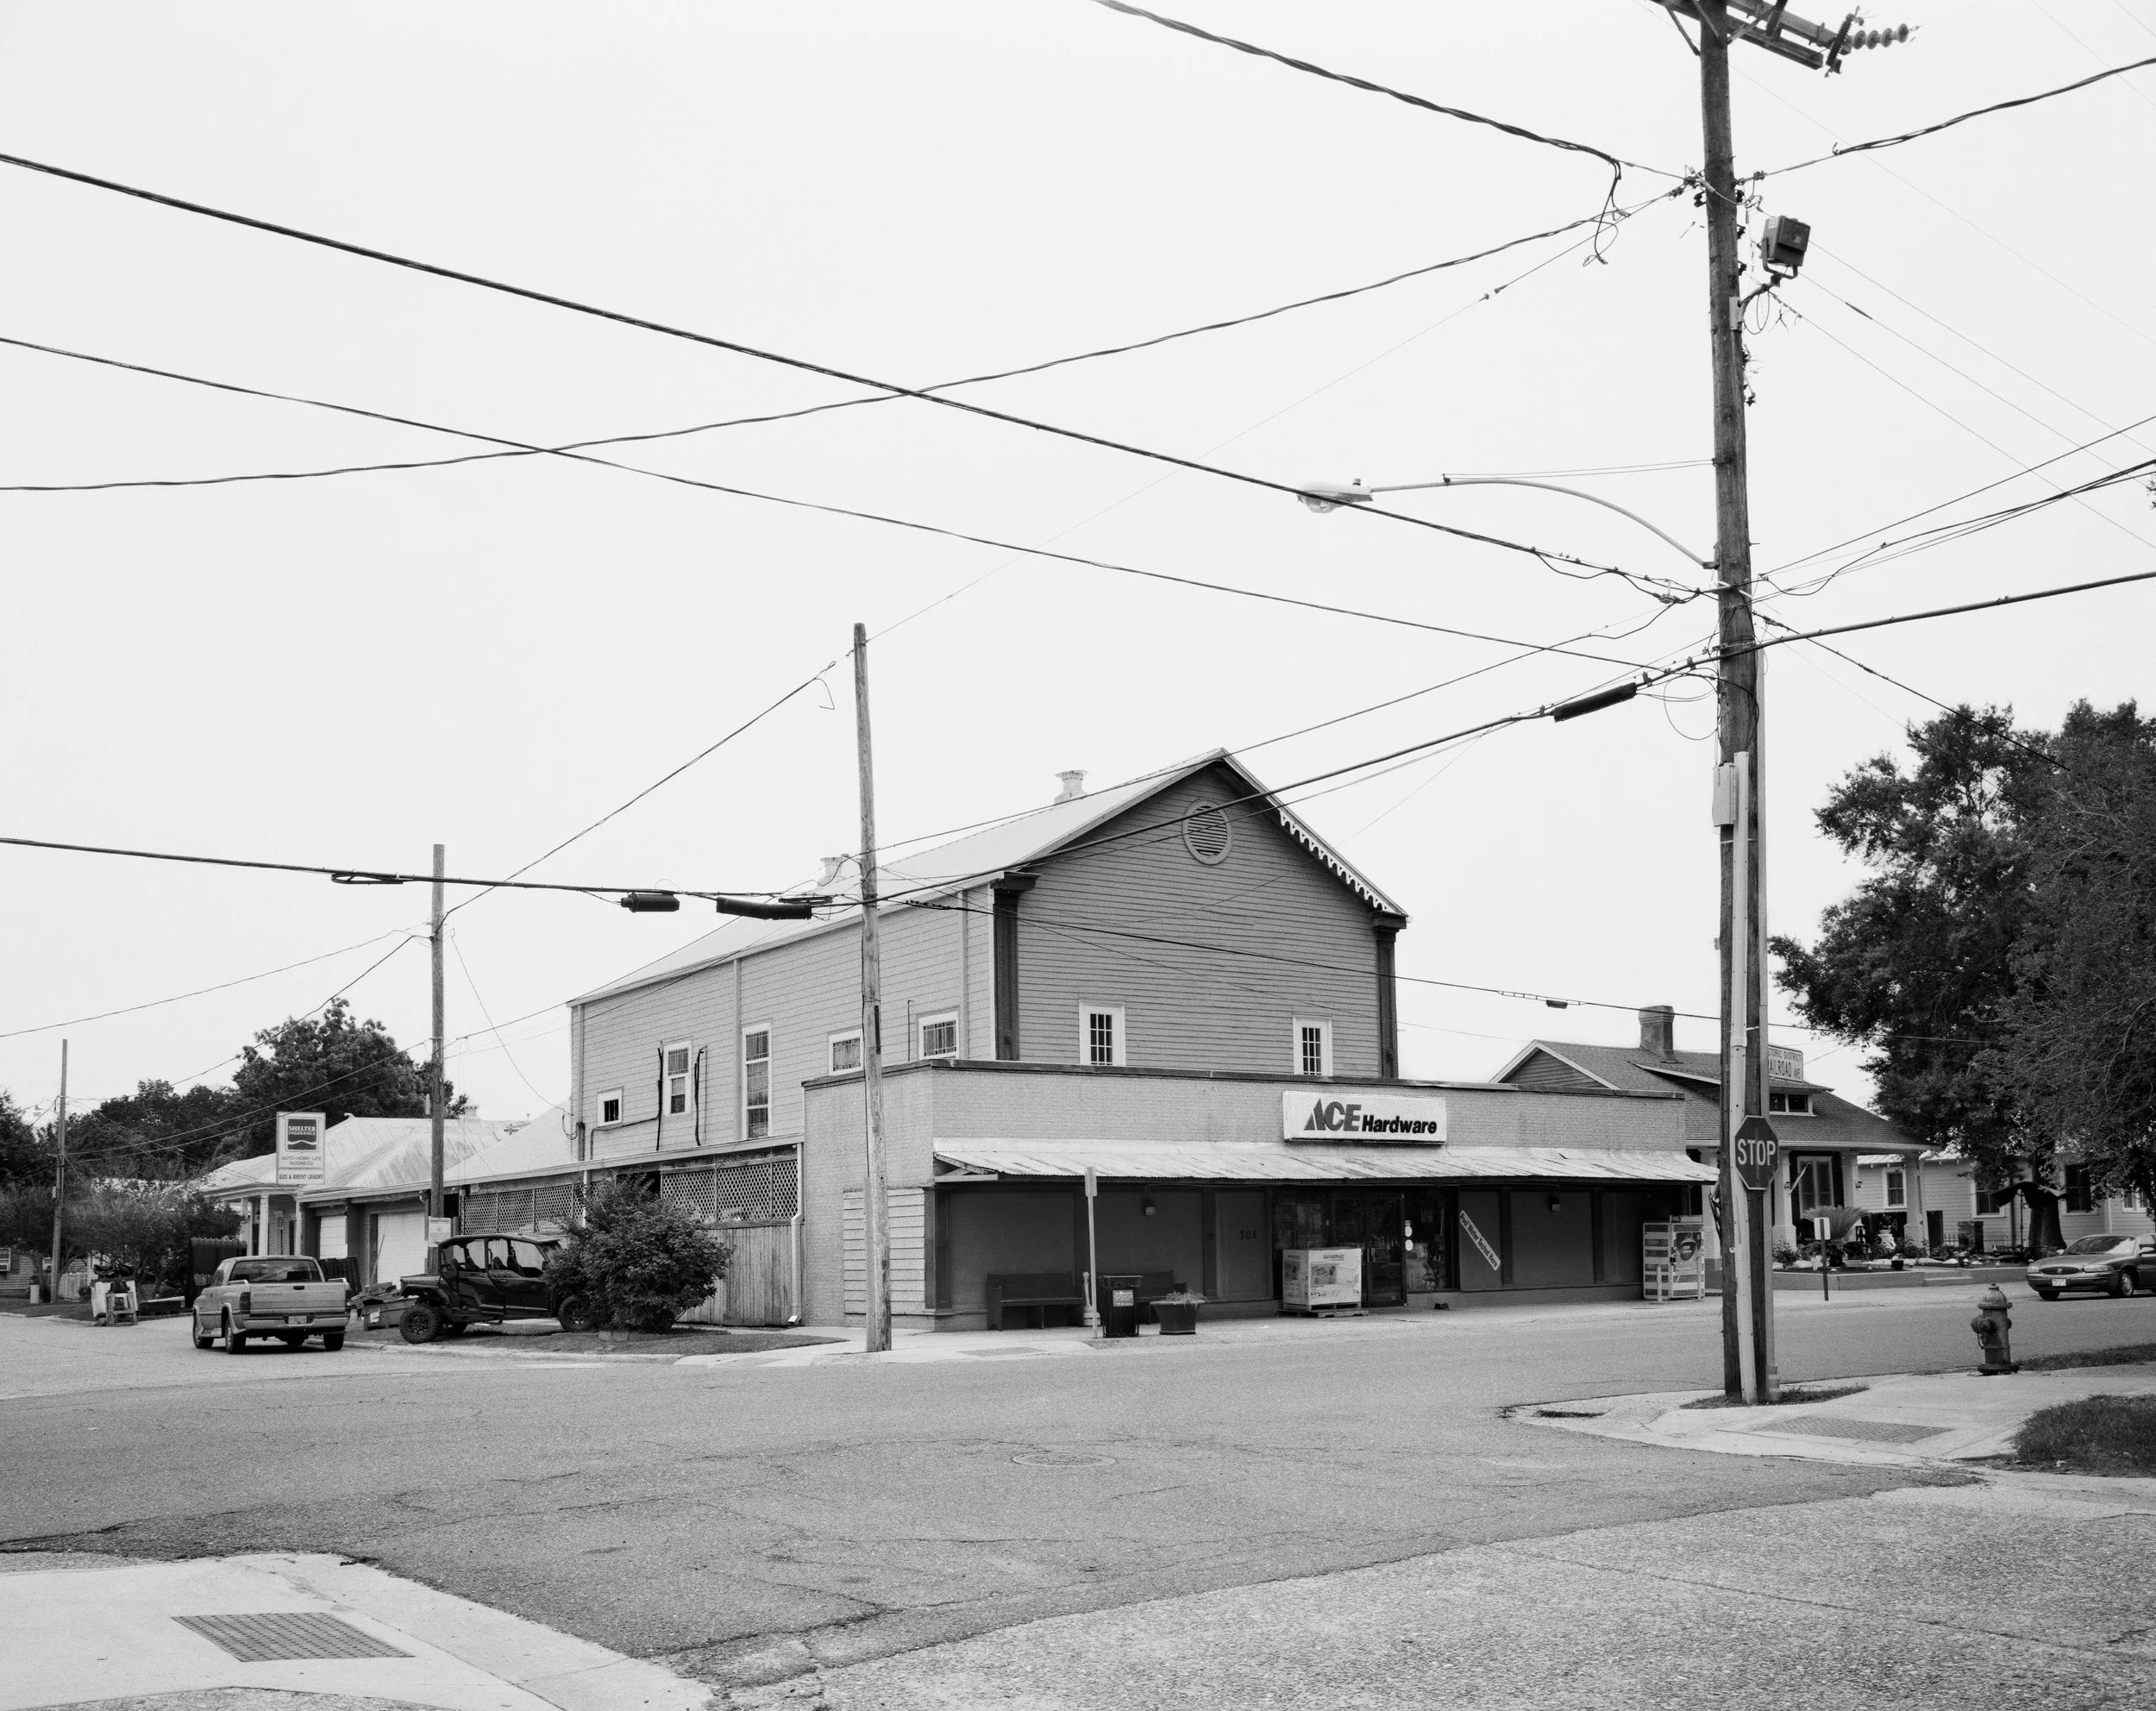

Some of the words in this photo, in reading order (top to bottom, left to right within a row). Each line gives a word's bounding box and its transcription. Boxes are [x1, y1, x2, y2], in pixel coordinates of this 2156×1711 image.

[1783, 1050, 1801, 1062] DISTRICT
[1304, 1098, 1362, 1131] ACE
[1362, 1114, 1438, 1134] Hardware
[1737, 1138, 1777, 1166] STOP
[1239, 1230, 1257, 1240] 301
[1460, 1213, 1470, 1227] Pool
[1467, 1223, 1479, 1241] Water
[1477, 1237, 1491, 1256] Tested
[1488, 1253, 1498, 1268] Here
